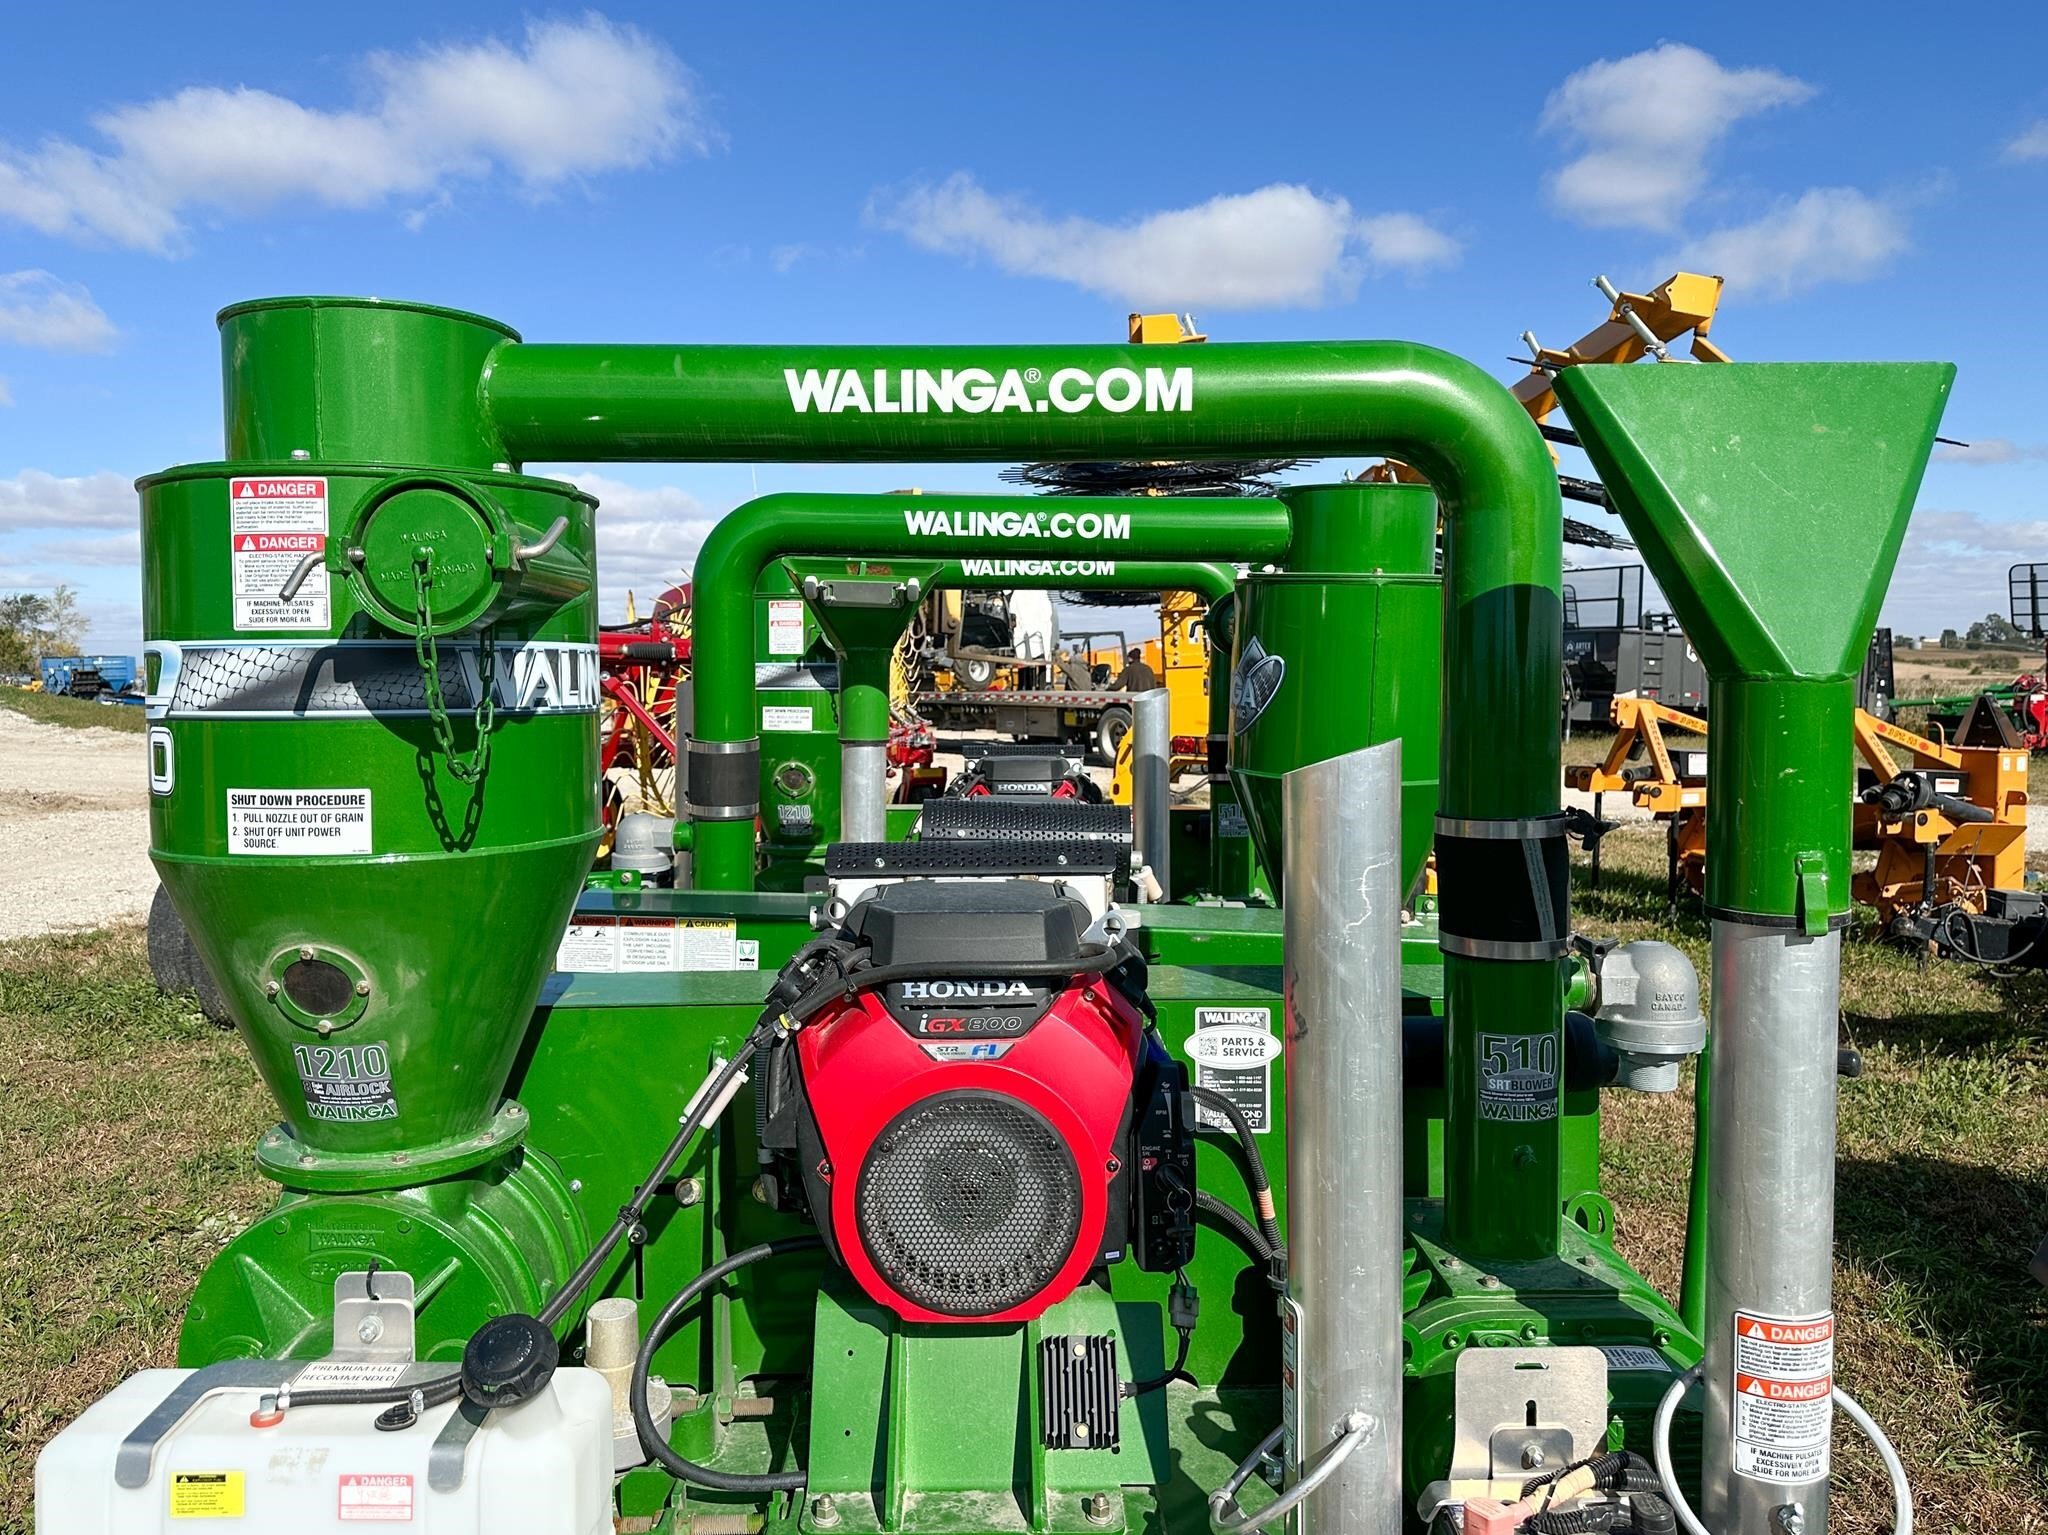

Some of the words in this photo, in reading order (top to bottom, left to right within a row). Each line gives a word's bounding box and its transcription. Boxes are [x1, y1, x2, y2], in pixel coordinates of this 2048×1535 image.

[258, 484, 316, 495] DANGER
[400, 530, 447, 543] WALINGA
[260, 537, 317, 548] DANGER
[381, 570, 411, 581] MADE
[433, 562, 476, 576] CANADA
[231, 794, 256, 805] SHUT
[260, 794, 292, 806] DOWN
[296, 794, 365, 805] PROCEDURE
[233, 813, 240, 822] 1.
[244, 813, 263, 822] PULL
[265, 814, 298, 823] NOZZLE
[300, 814, 318, 823] OUT
[320, 814, 332, 822] OF
[335, 813, 364, 822] GRAIN
[778, 805, 811, 820] 1210
[233, 827, 240, 836] 2.
[244, 827, 265, 836] SHUT
[267, 828, 282, 836] OFF
[285, 828, 305, 836] UNIT
[308, 828, 341, 836] POWER
[244, 839, 279, 848] SOURCE.
[695, 920, 729, 928] CAUTION
[902, 980, 1033, 999] HONDA
[1222, 1038, 1254, 1046] PARTS
[1258, 1038, 1265, 1046] &
[972, 1044, 997, 1055] FI
[1223, 1048, 1265, 1056] SERVICE
[1482, 1034, 1557, 1077] 510
[295, 1046, 387, 1079] 1210
[307, 1100, 397, 1119] WALINGA
[1481, 1102, 1557, 1120] WALINGA
[318, 1232, 377, 1247] WALINGA
[1771, 1325, 1829, 1340] DANGER
[372, 1364, 398, 1372] FUEL
[1770, 1380, 1828, 1398] DANGER
[1760, 1450, 1793, 1460] MACHINE
[1796, 1449, 1822, 1459] PULSATES
[1805, 1459, 1818, 1467] OPEN
[1752, 1465, 1772, 1475] SLIDE
[1792, 1469, 1809, 1477] MORE
[361, 1476, 407, 1486] DANGER
